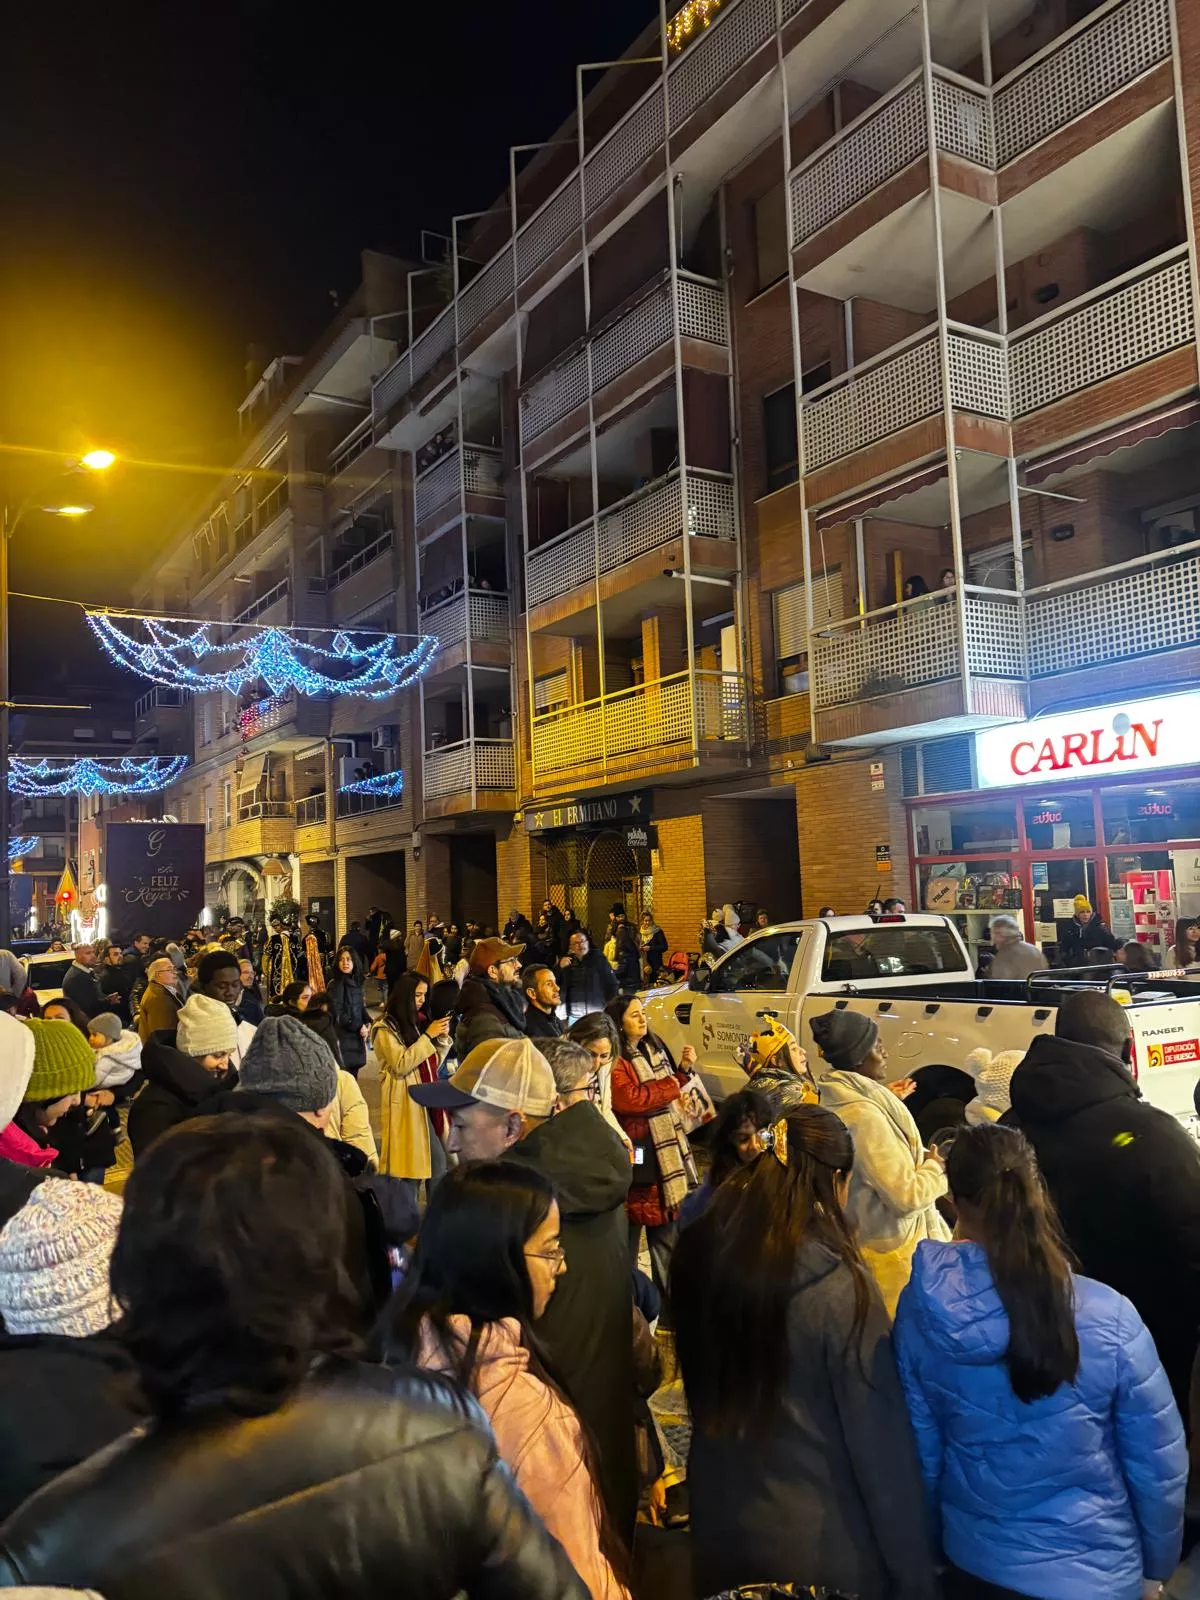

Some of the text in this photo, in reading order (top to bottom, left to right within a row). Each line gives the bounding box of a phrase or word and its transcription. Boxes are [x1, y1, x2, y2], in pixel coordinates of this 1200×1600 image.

[553, 809, 563, 826] EL
[146, 828, 166, 857] G
[151, 876, 179, 886] FELIZ
[125, 887, 172, 908] Reyes
[1142, 1026, 1184, 1036] RANGER
[1164, 1052, 1198, 1063] DE HUESCA
